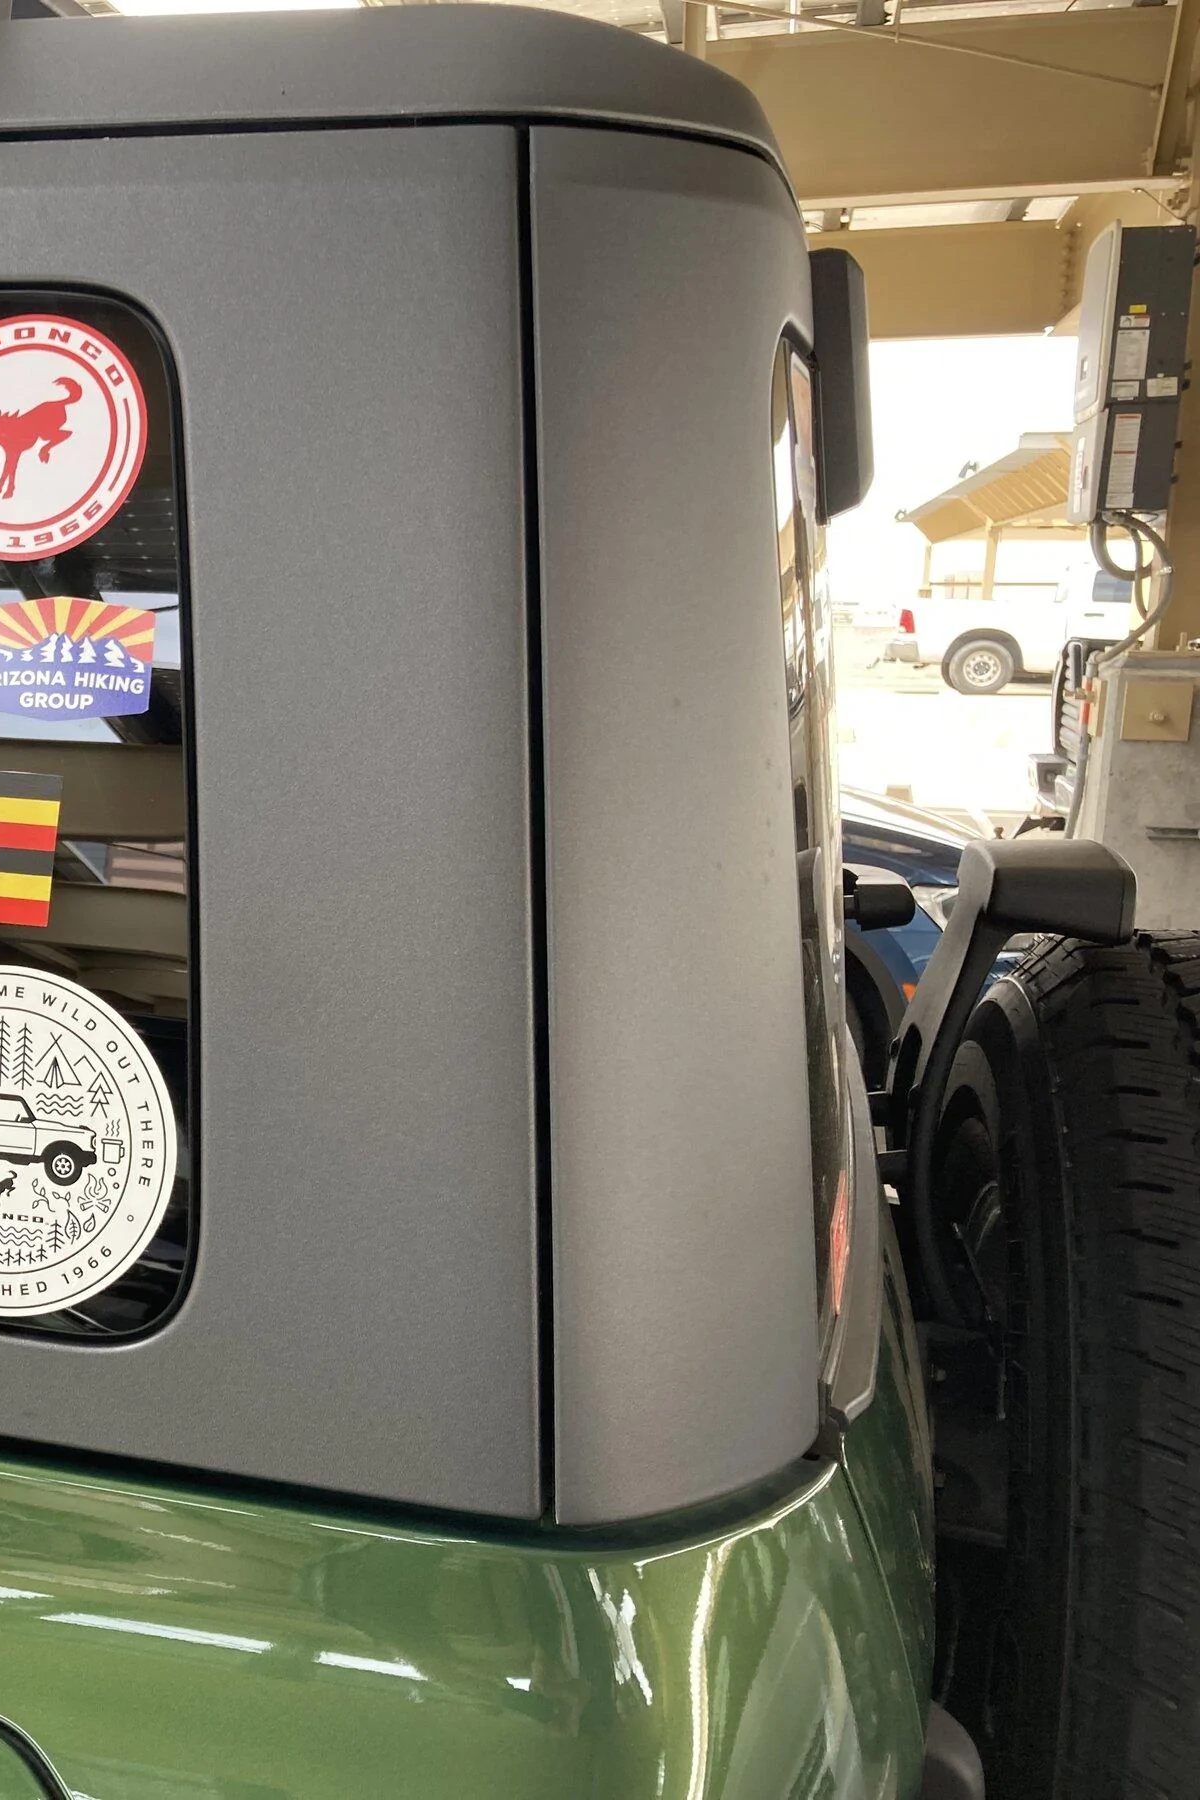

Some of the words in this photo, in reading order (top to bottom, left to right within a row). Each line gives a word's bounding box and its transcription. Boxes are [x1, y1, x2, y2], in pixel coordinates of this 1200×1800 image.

[6, 500, 103, 548] 1966
[19, 692, 94, 710] GROUP
[74, 671, 145, 695] HIKING
[42, 992, 98, 1032] WILD
[106, 1040, 140, 1087] OUT
[136, 1100, 155, 1188] THERE
[61, 1245, 112, 1285] 1966
